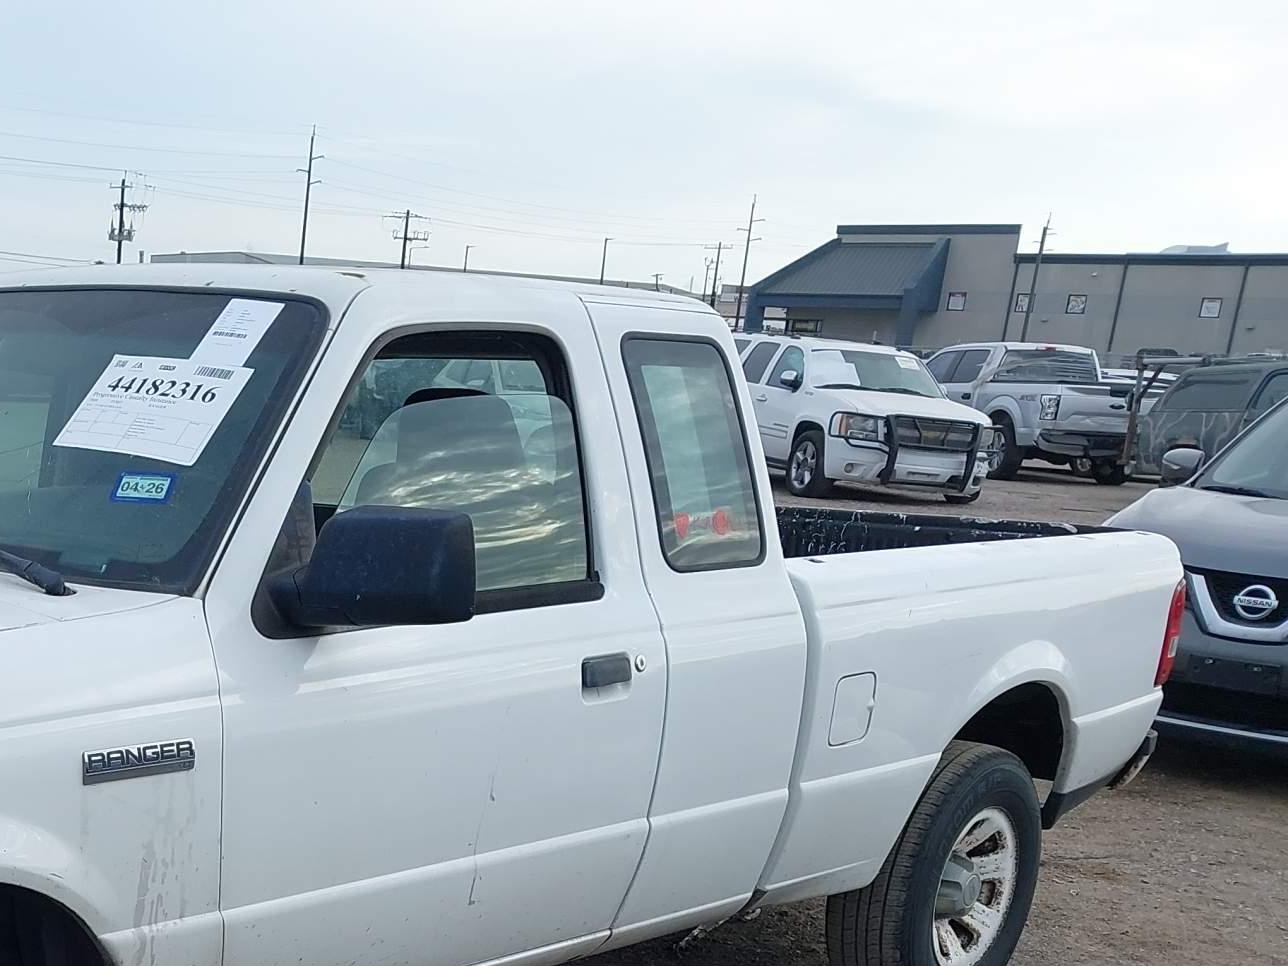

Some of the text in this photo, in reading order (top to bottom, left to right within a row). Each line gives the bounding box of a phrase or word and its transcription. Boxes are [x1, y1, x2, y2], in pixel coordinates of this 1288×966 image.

[107, 375, 223, 404] 44182316
[121, 481, 166, 495] 04 26
[1236, 597, 1273, 607] NISSAN
[87, 740, 195, 771] RANGER
